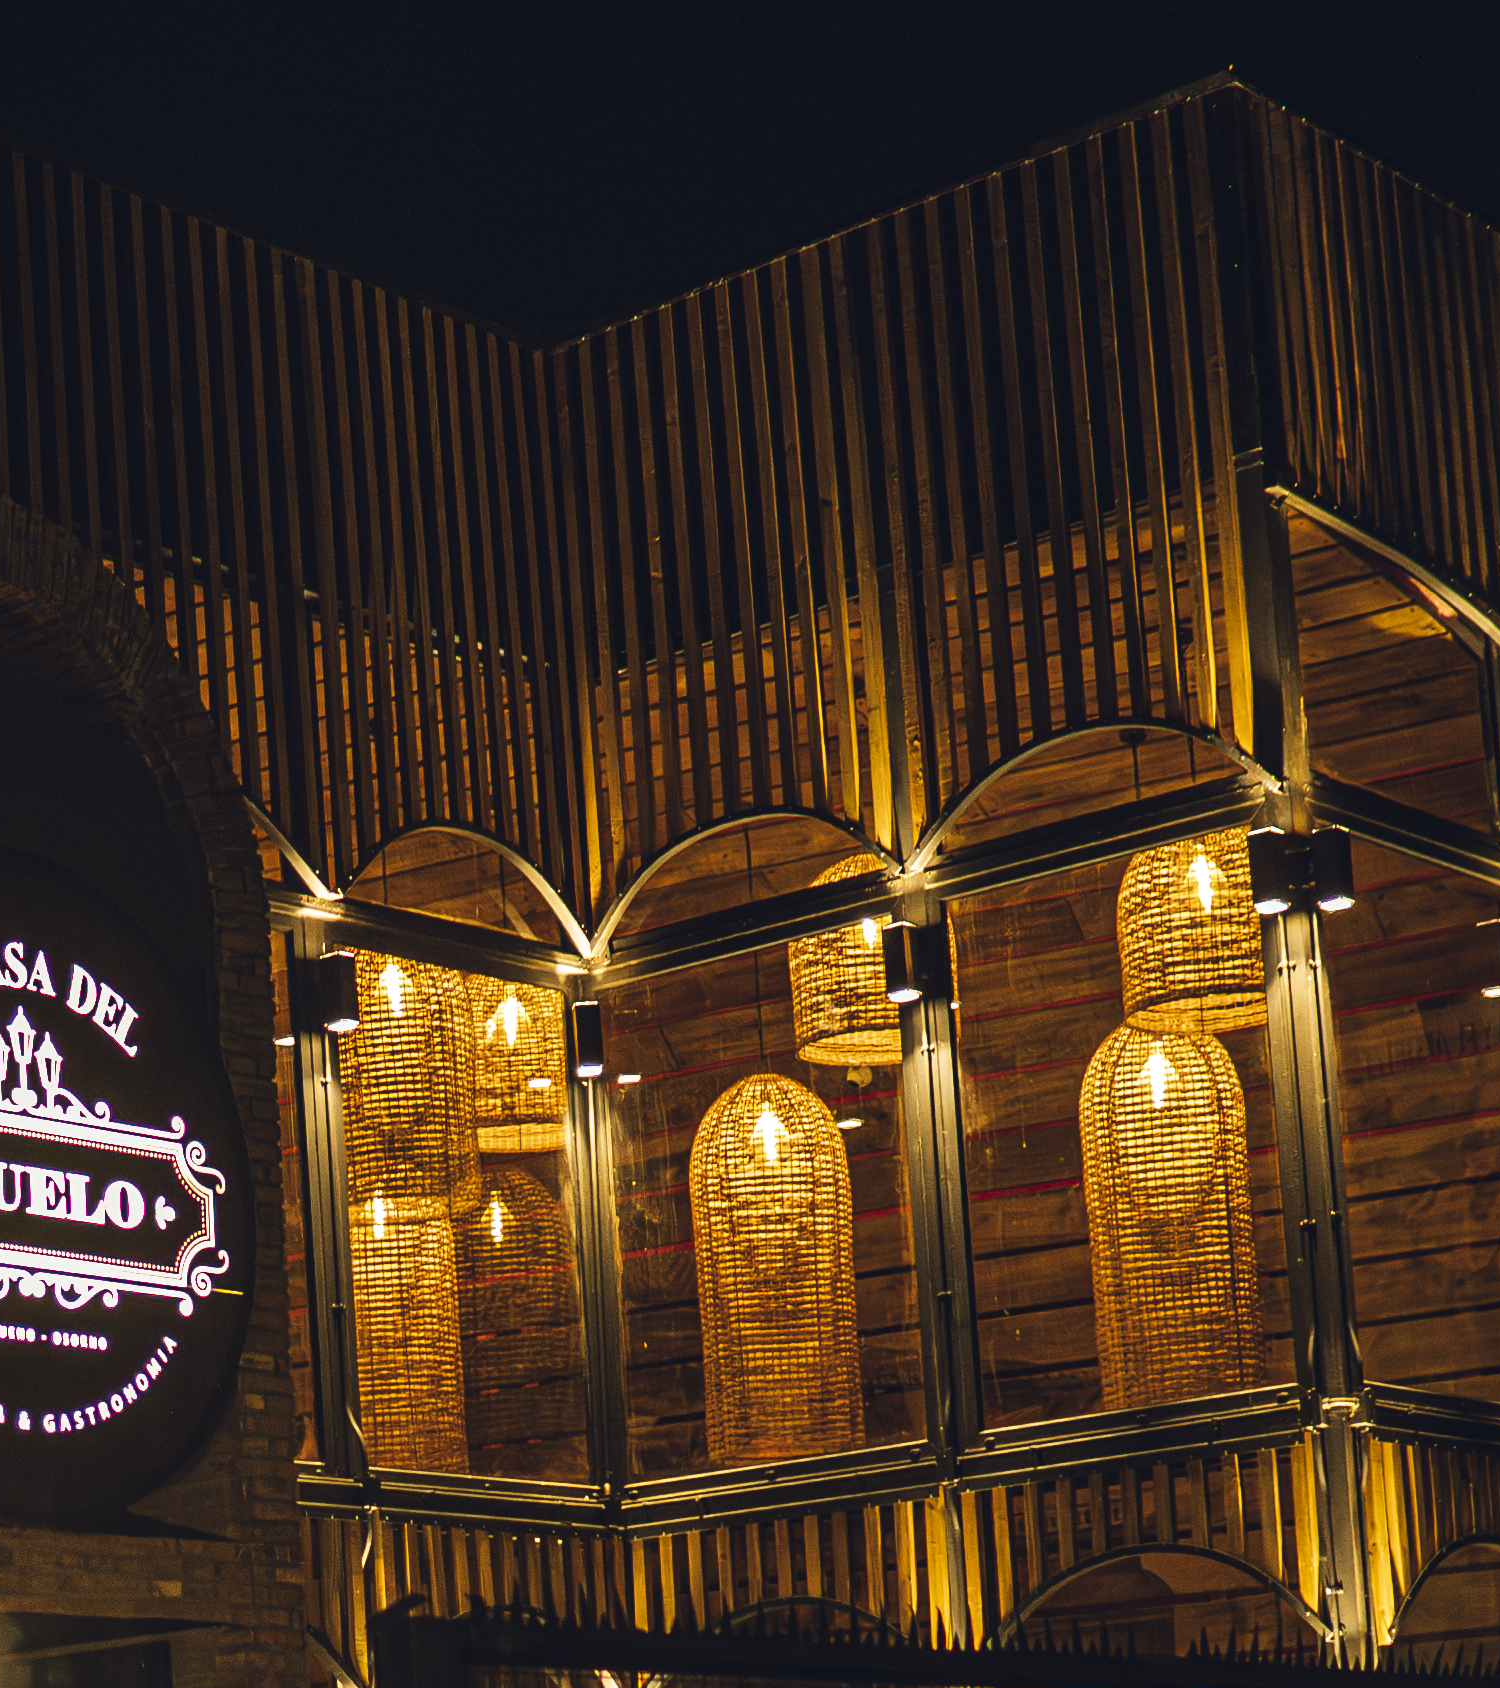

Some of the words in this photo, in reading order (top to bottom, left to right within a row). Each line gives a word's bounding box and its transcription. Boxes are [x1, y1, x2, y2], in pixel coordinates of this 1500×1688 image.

[66, 963, 139, 1058] DEL
[17, 1409, 32, 1432] &
[42, 1335, 178, 1434] GASTRONOMIA
